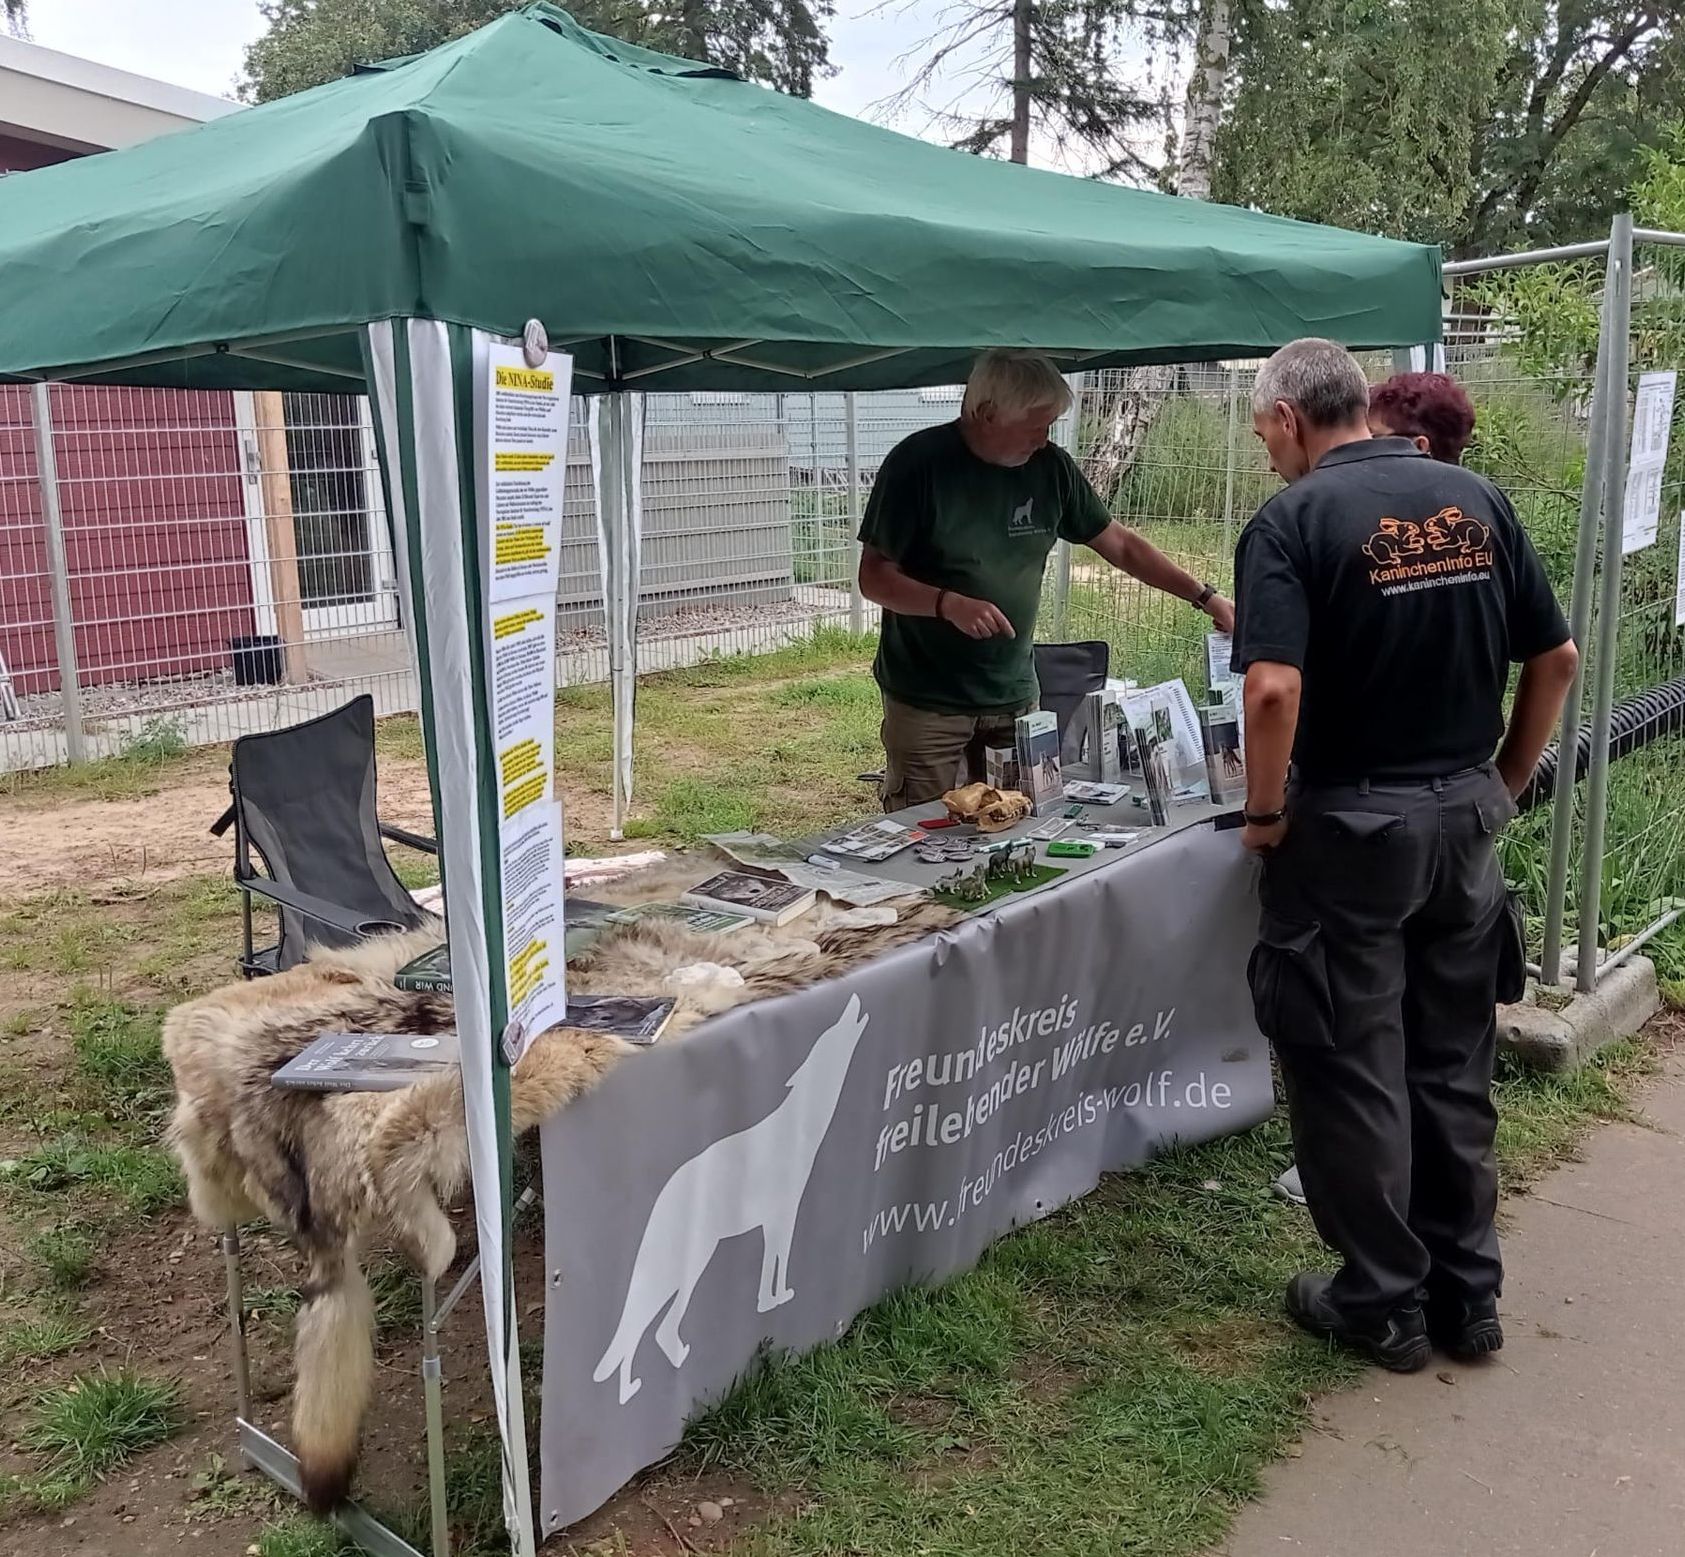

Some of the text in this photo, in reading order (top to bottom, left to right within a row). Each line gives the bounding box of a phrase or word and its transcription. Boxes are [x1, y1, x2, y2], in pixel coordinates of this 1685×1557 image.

[496, 371, 554, 391] Die NINA-Studie
[1369, 551, 1493, 585] KaninchenInfo EU
[1381, 571, 1490, 597] www.kanincheninfo.eu
[415, 980, 434, 991] WIR
[882, 993, 1078, 1112] Freundeskreis
[873, 1007, 1176, 1172] freilebender Wölfe e. V.
[862, 1070, 1233, 1255] www.freundeskreis-wolf.de
